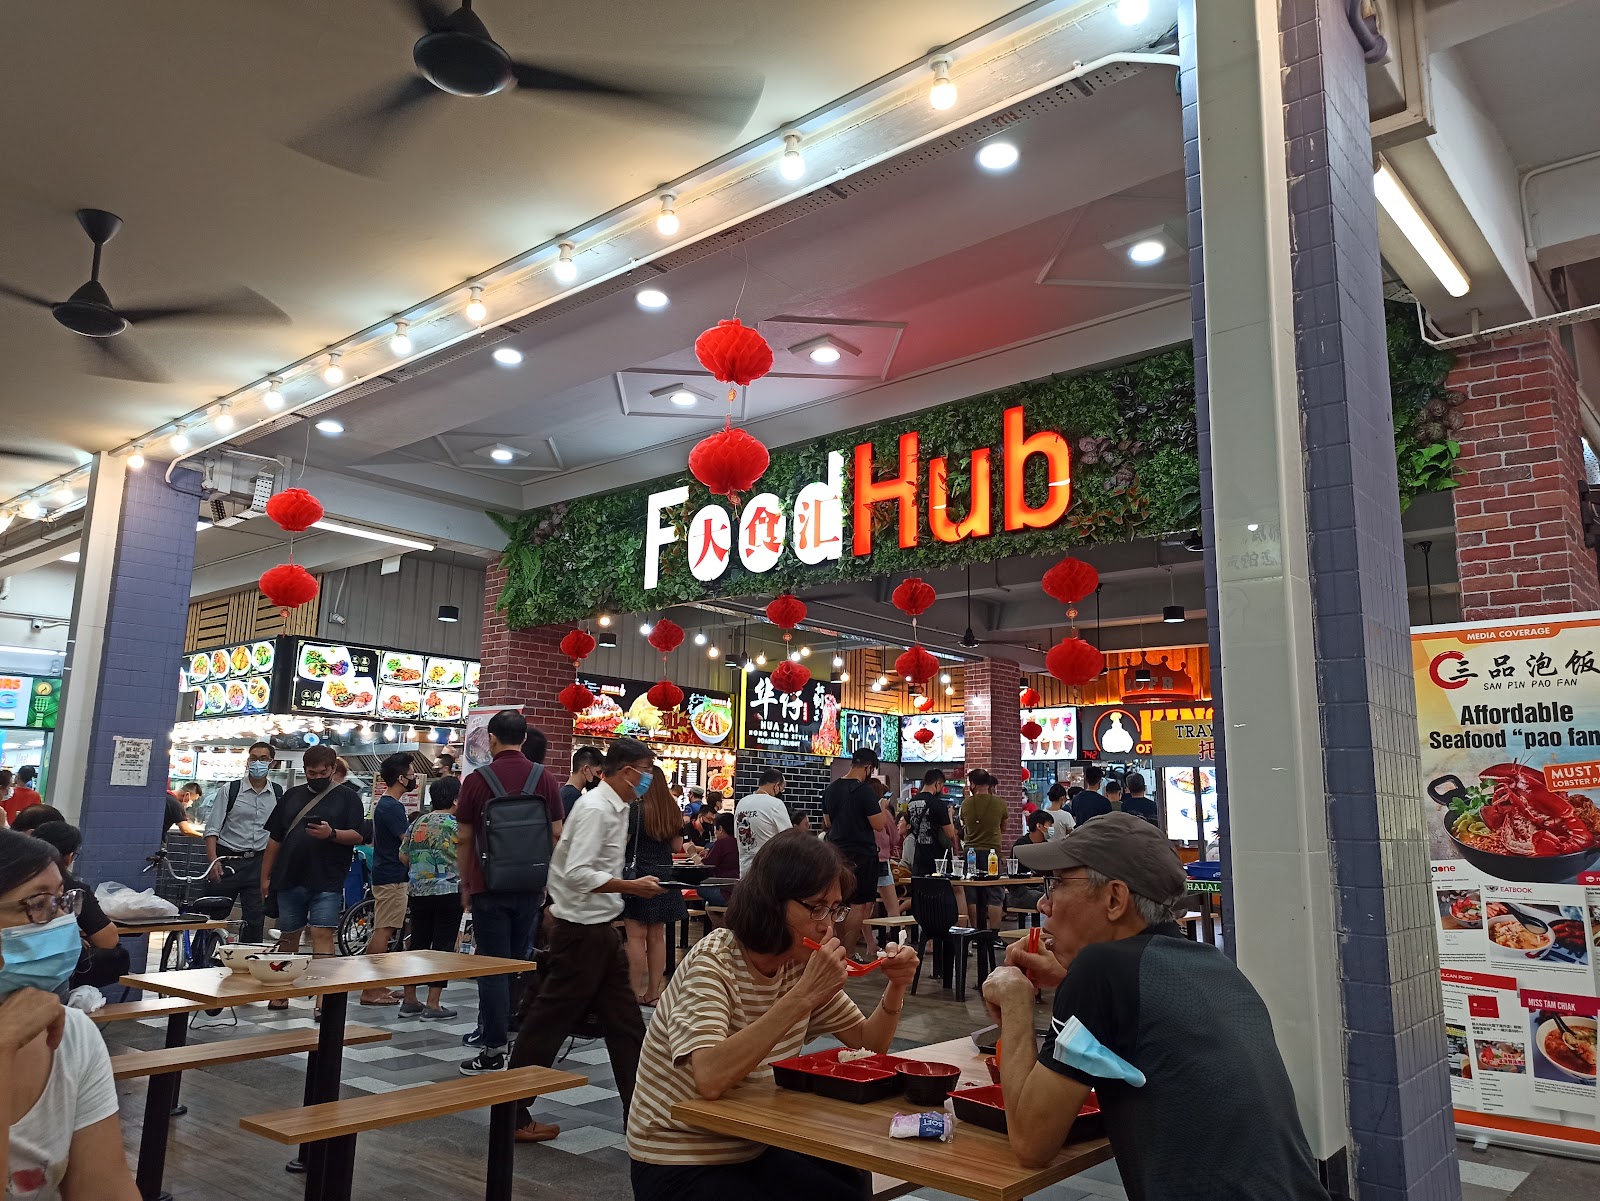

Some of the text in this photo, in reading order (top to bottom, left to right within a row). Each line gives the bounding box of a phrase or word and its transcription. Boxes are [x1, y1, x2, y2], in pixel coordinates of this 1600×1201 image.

[643, 405, 1071, 590] Food Hub
[1466, 627, 1551, 641] MEDIA COVERAGE
[1448, 649, 1600, 681] 三品泡饭
[1483, 678, 1578, 690] SAN PIN PAO FAN
[1460, 701, 1574, 726] Affordable
[760, 720, 799, 733] HUA ZAI
[748, 729, 809, 741] HONG KONG STYLE
[1429, 729, 1507, 749] Seafood
[1082, 750, 1098, 759] 742
[1551, 765, 1592, 779] MUST
[1552, 777, 1591, 788] LOBSTER
[1187, 882, 1220, 892] HALAL
[1500, 886, 1533, 894] EATBOOK
[1527, 997, 1577, 1012] MISS TAM CHIAK
[922, 1118, 943, 1127] SOFT
